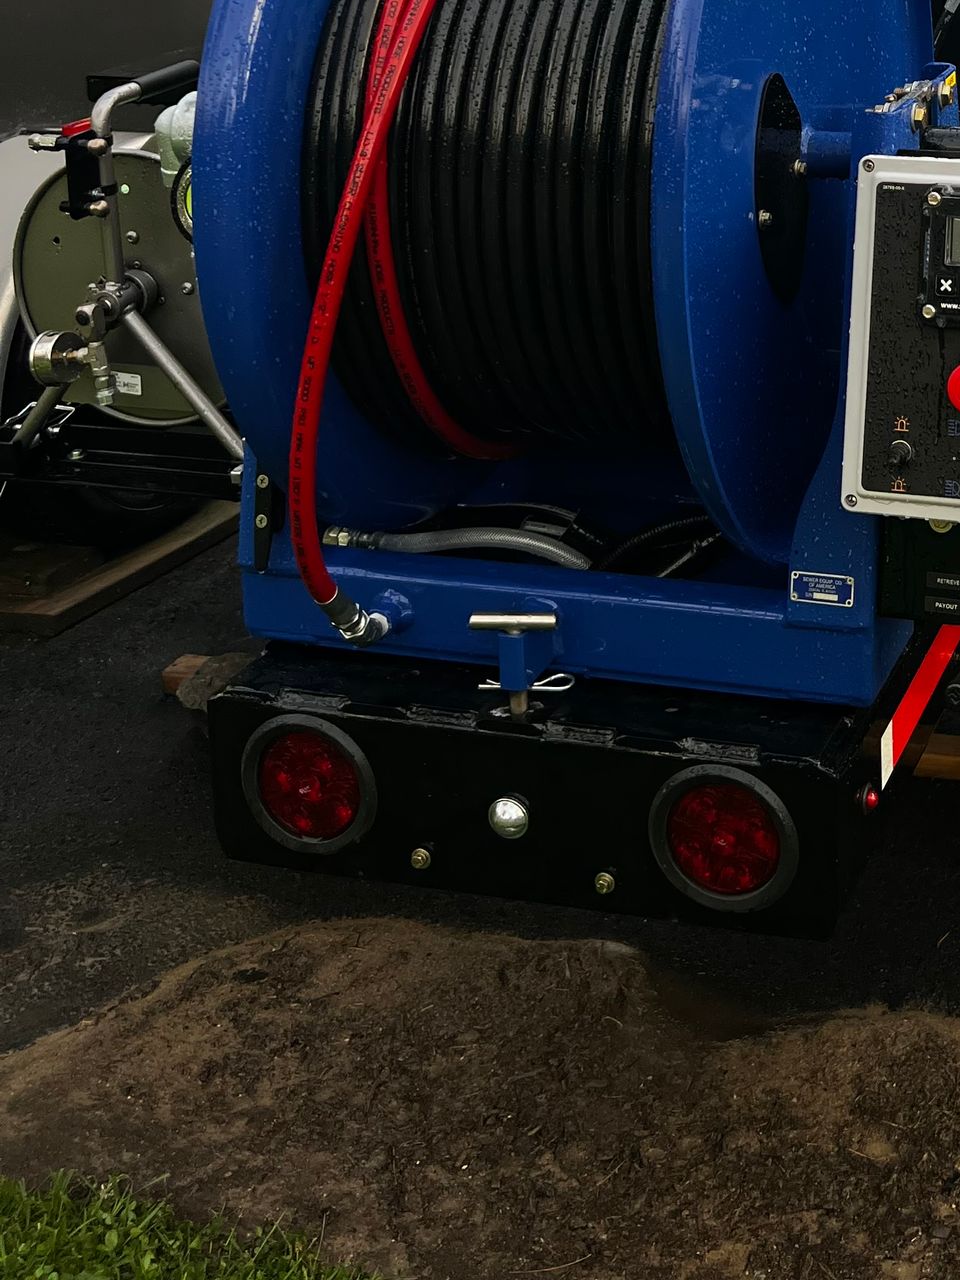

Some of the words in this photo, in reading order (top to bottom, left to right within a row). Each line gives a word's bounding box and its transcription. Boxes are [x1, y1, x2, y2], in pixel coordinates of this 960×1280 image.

[392, 35, 406, 58] HOSE
[372, 63, 397, 114] PRODUCTS
[347, 162, 365, 196] SEWER
[937, 578, 960, 586] RETRIEVE
[935, 602, 958, 610] PAYOUT
